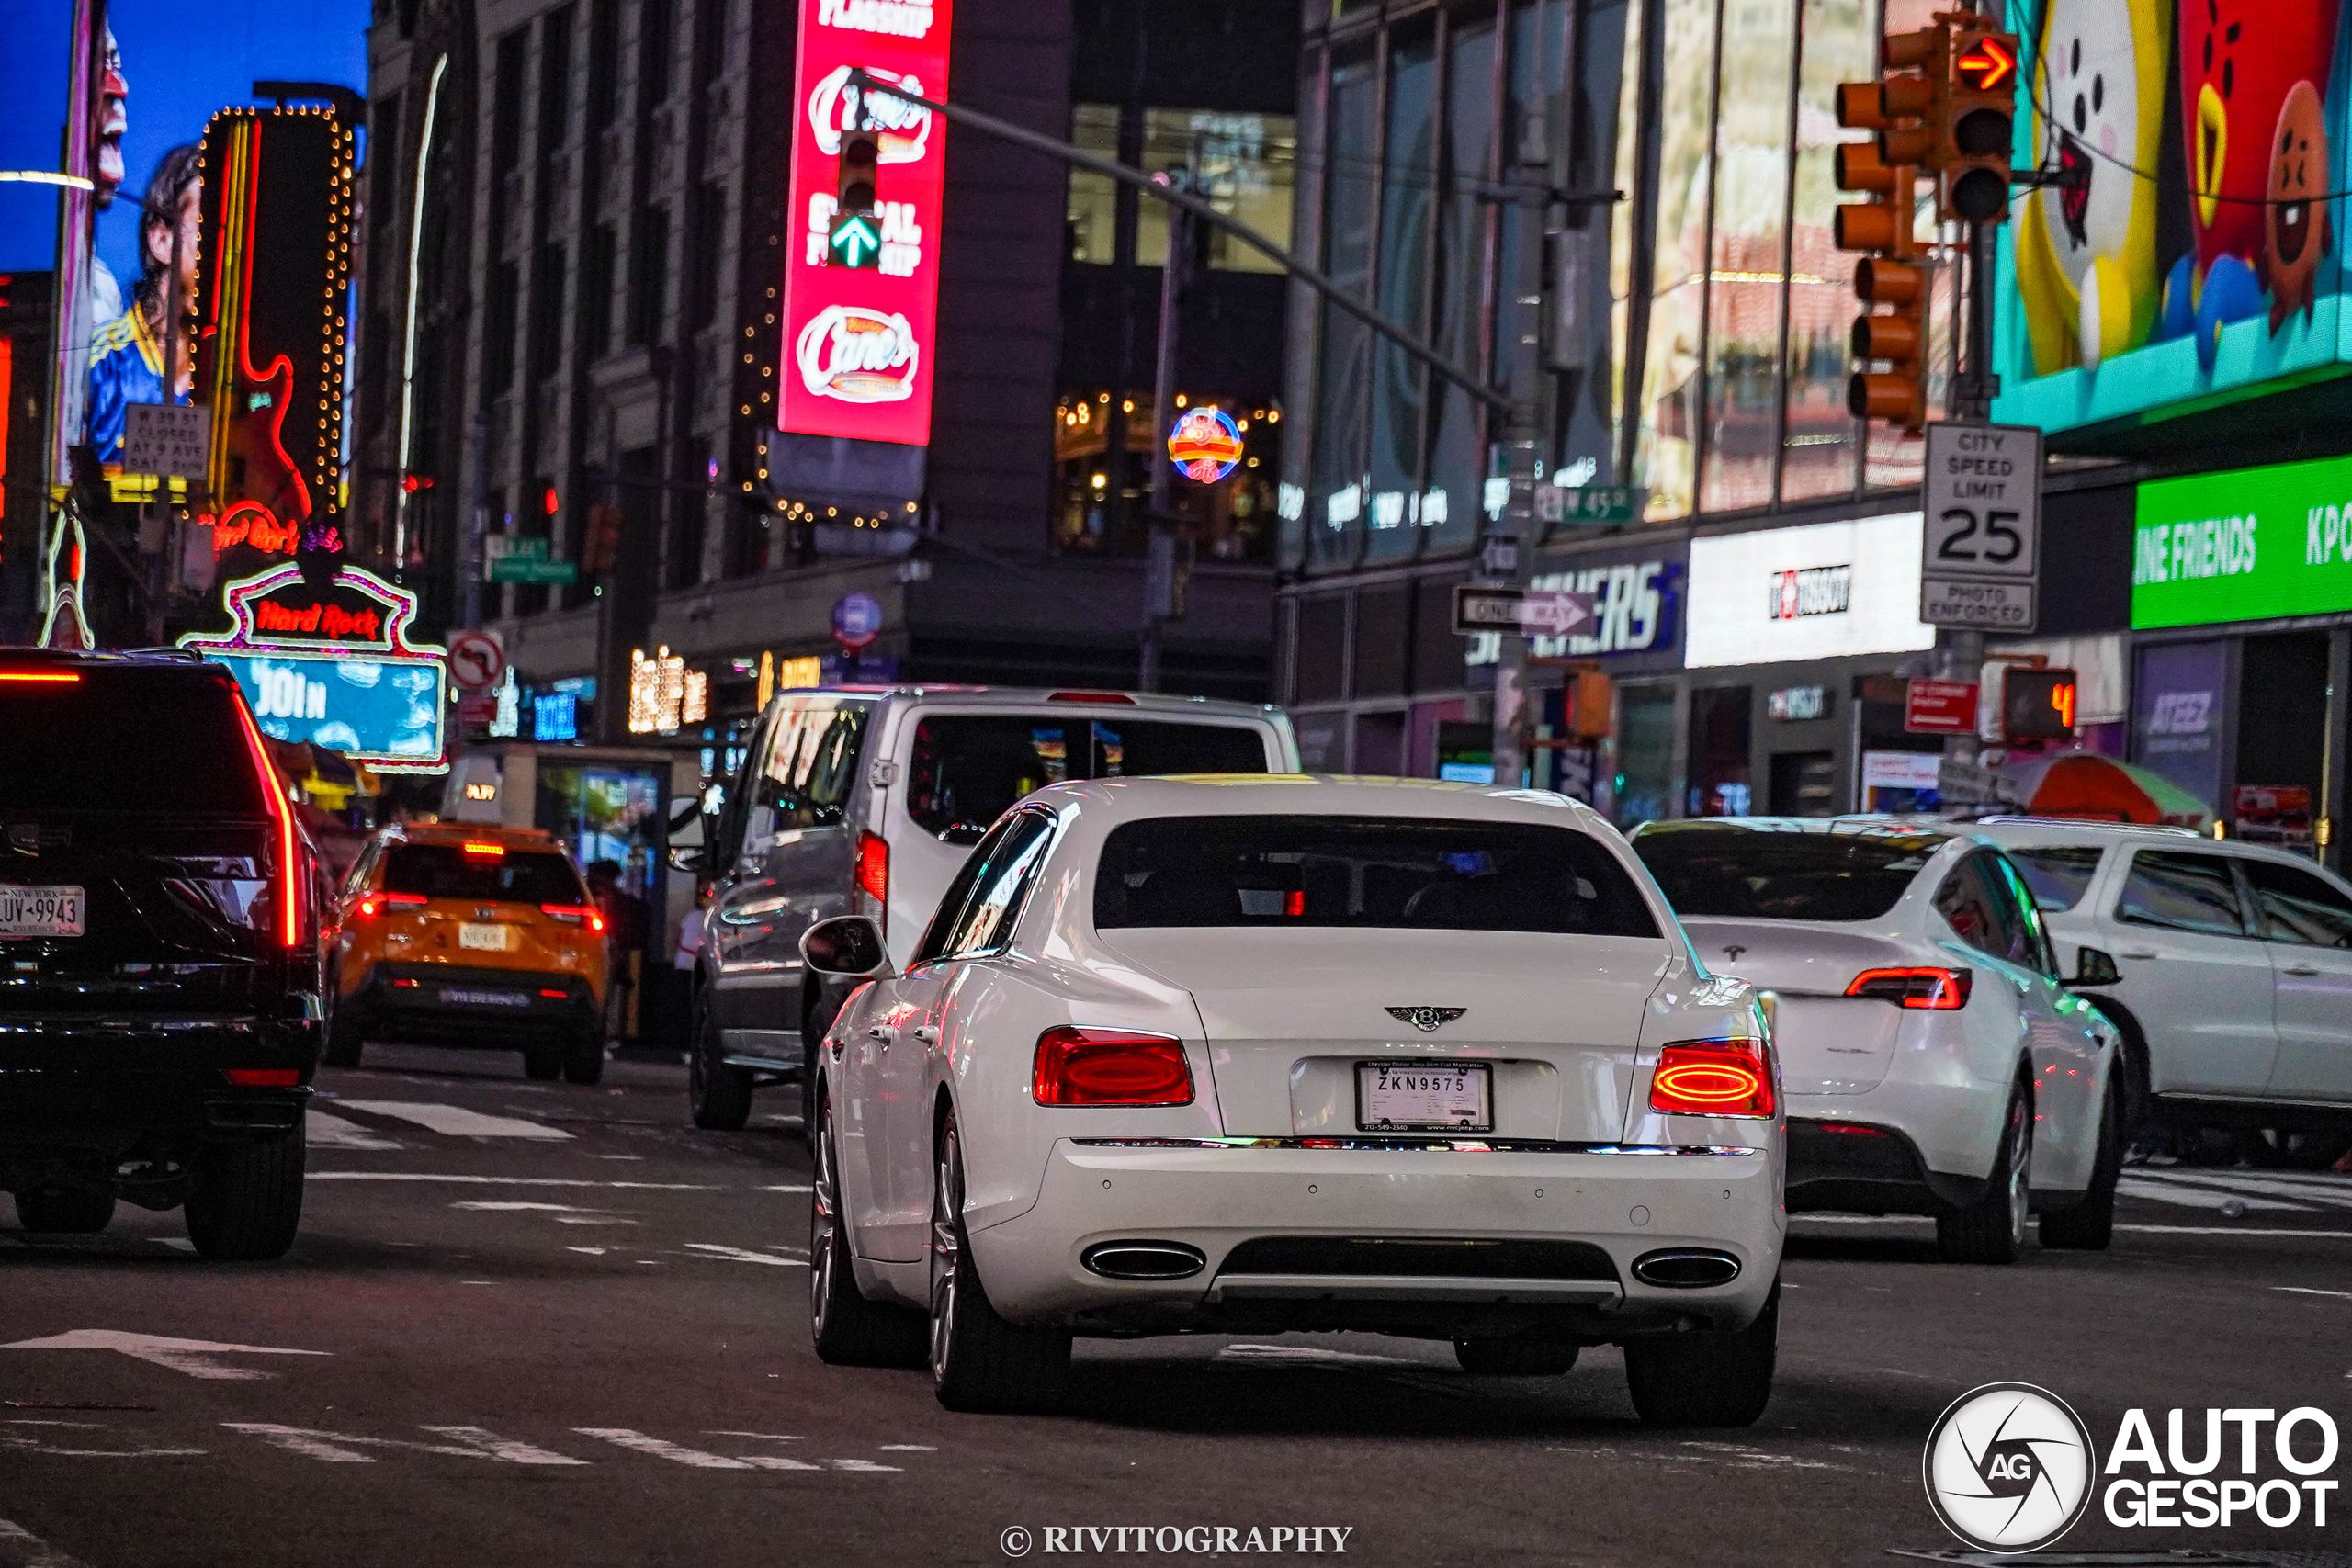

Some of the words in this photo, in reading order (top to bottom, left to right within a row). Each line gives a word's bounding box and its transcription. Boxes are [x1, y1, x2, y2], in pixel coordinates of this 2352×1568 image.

[1958, 433, 2005, 452] CITY
[1947, 457, 2013, 477] SPEED
[1952, 480, 2006, 500] LIMIT
[1939, 509, 2020, 562] 25
[2132, 524, 2170, 585] INE
[2171, 513, 2257, 581] FRIENDS
[1947, 584, 2007, 604] PHOTO
[256, 600, 322, 632] Hard
[322, 604, 380, 641] Rock
[1928, 602, 2023, 622] ENFORCED
[10, 888, 32, 898] NEW
[35, 889, 59, 899] YORK
[1378, 1077, 1464, 1092] ZKN9575
